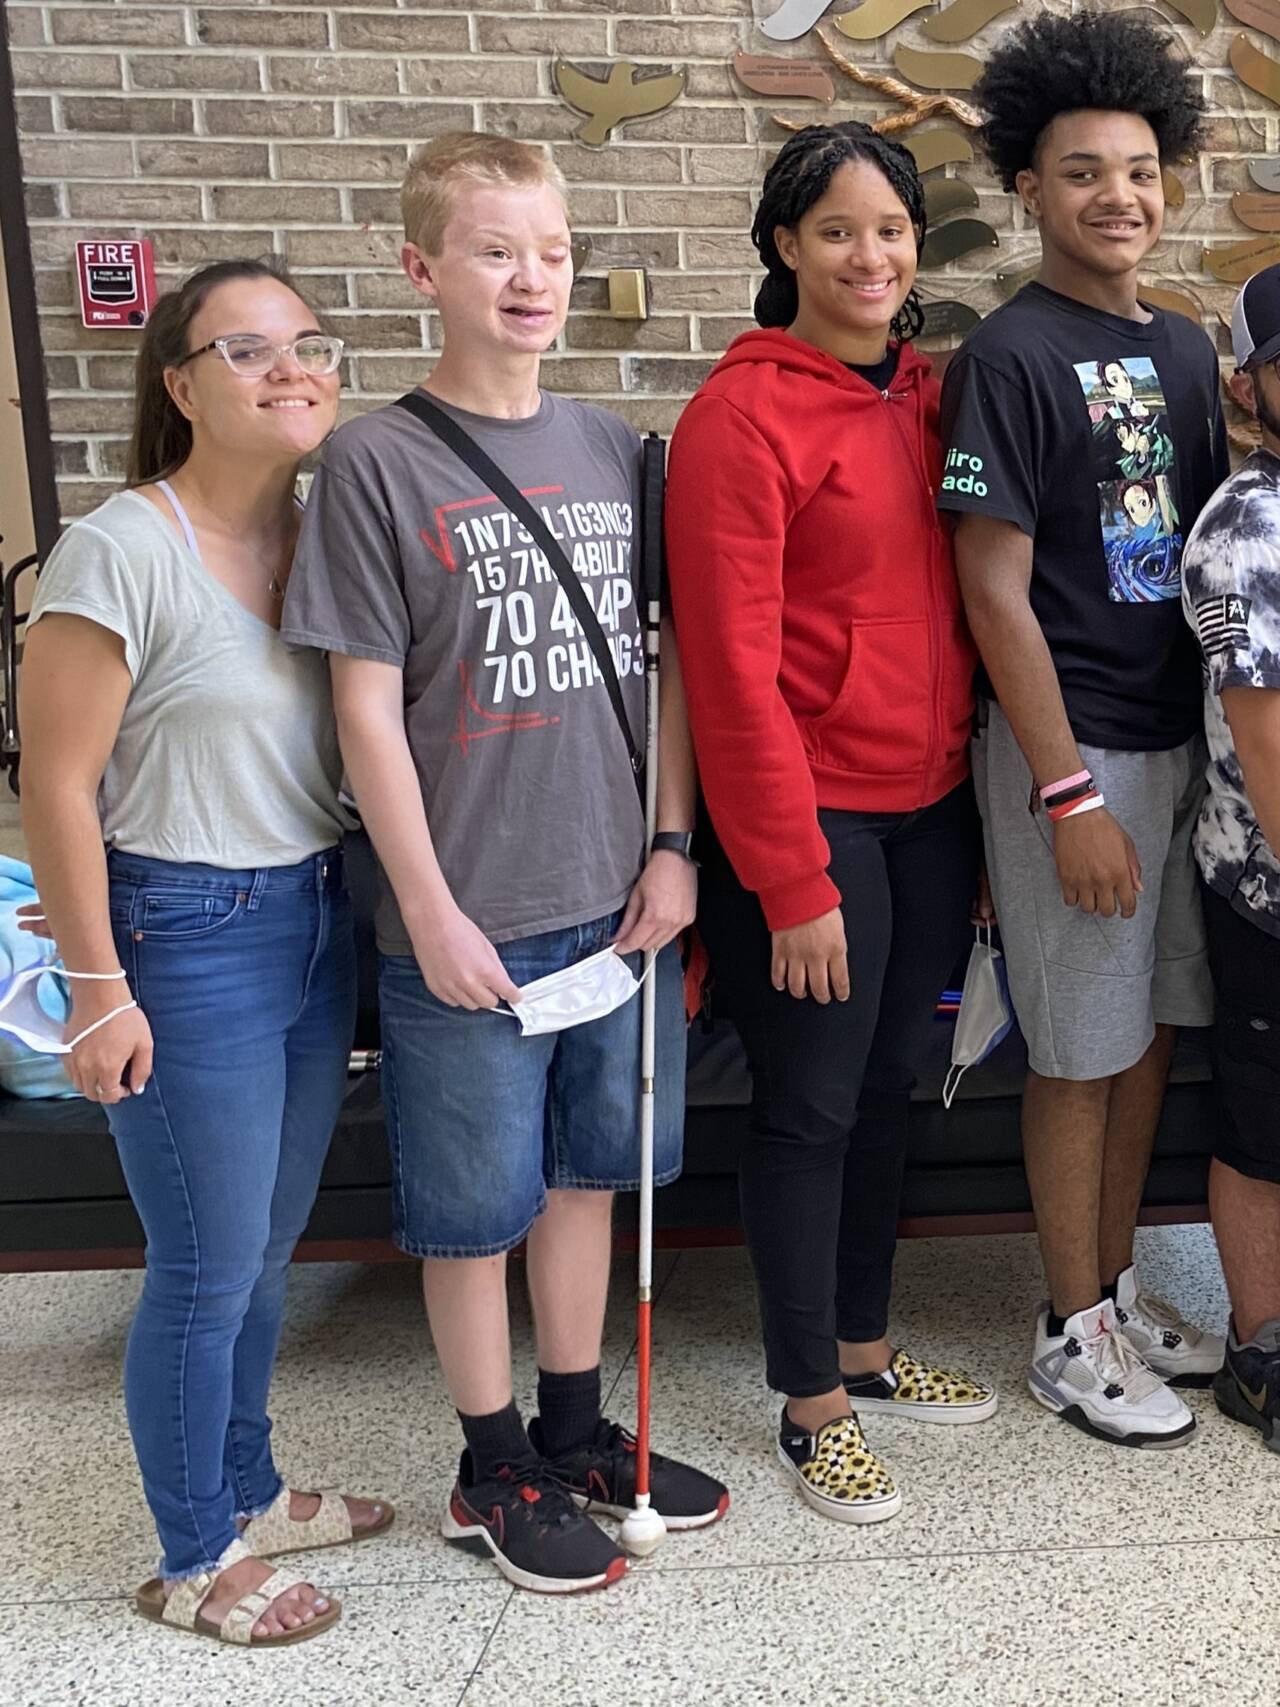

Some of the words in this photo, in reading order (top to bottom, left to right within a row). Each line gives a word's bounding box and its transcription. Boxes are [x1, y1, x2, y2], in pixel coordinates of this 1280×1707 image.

[84, 245, 135, 263] FIRE
[942, 475, 988, 497] ado
[467, 556, 506, 594] 15
[511, 548, 558, 586] 7H
[476, 591, 536, 652] 70
[484, 650, 536, 703] 70
